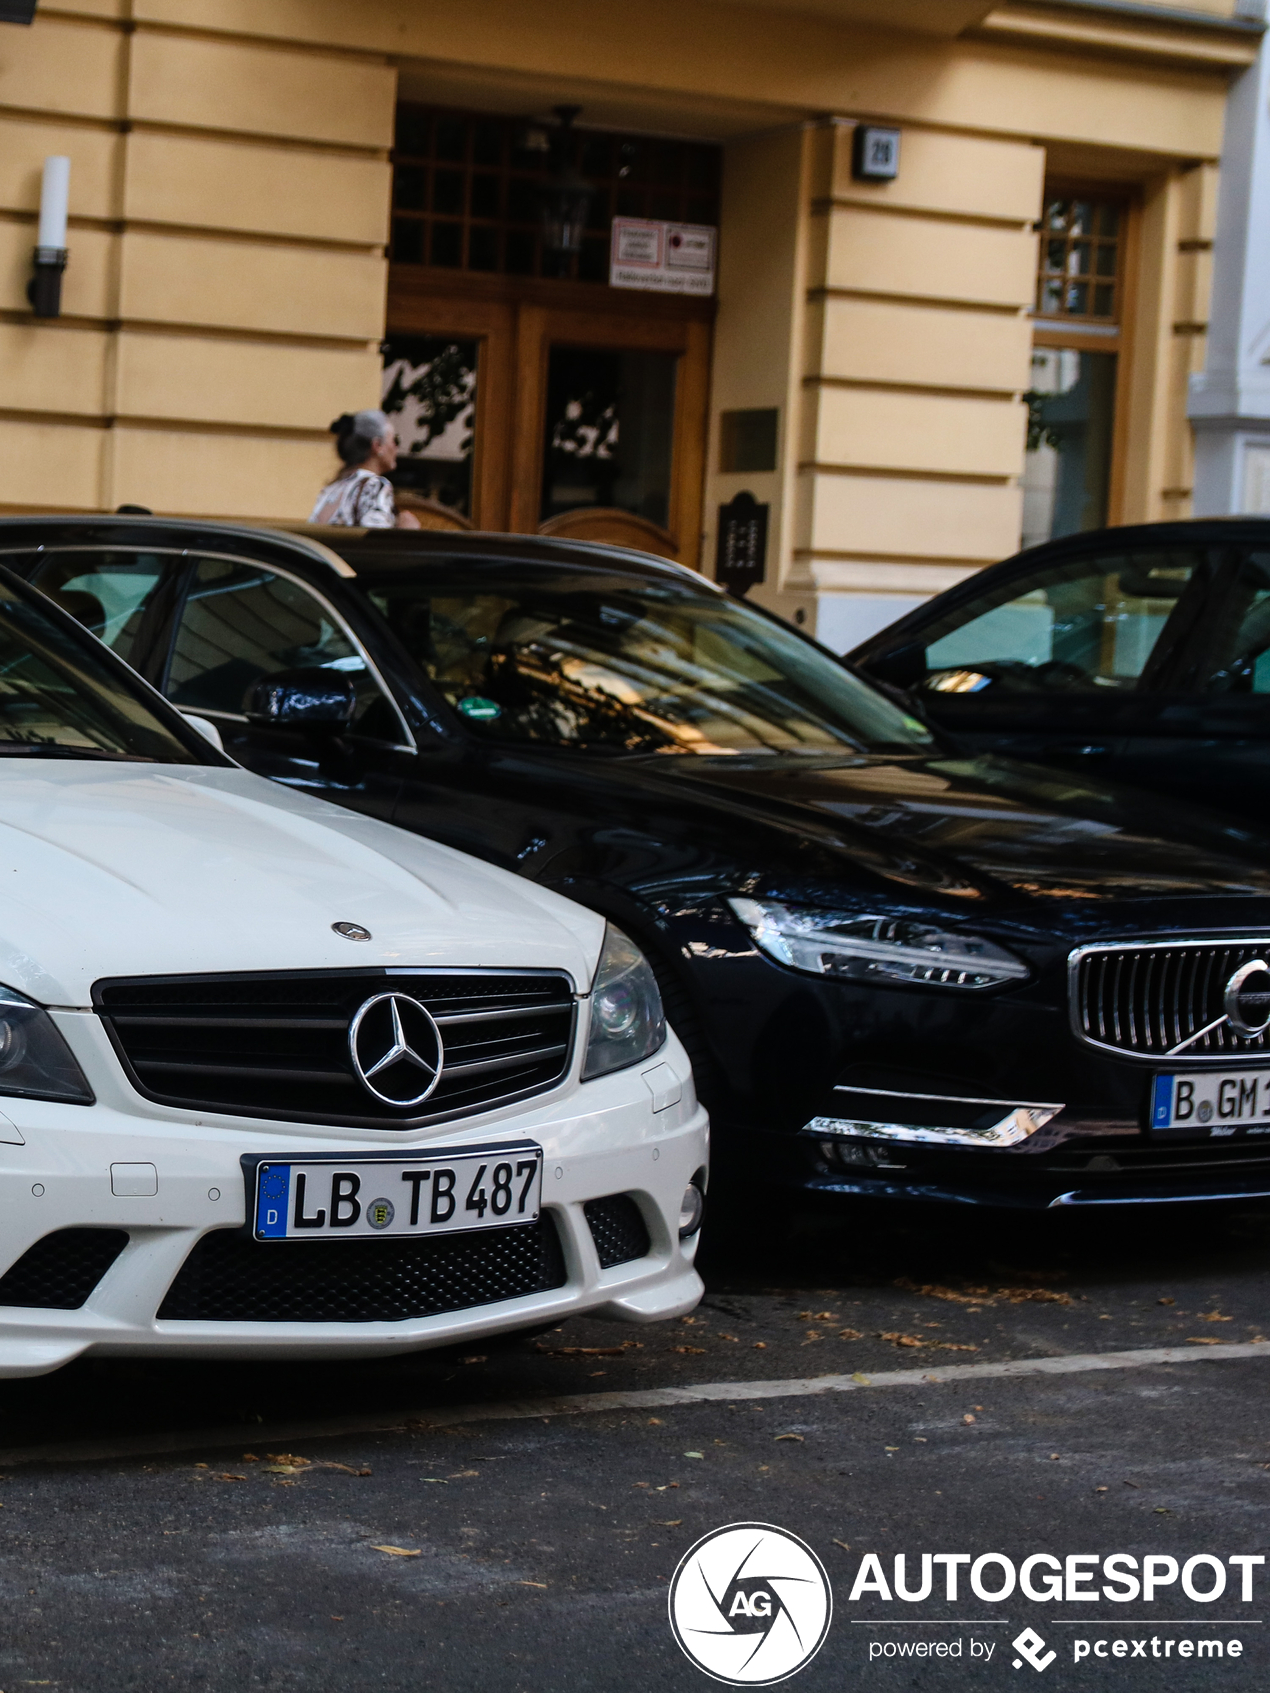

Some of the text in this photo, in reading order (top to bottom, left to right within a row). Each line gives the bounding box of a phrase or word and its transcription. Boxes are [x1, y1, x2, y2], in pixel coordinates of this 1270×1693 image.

[1175, 1080, 1194, 1121] B
[294, 1158, 537, 1228] LB TB 487
[267, 1209, 278, 1225] D
